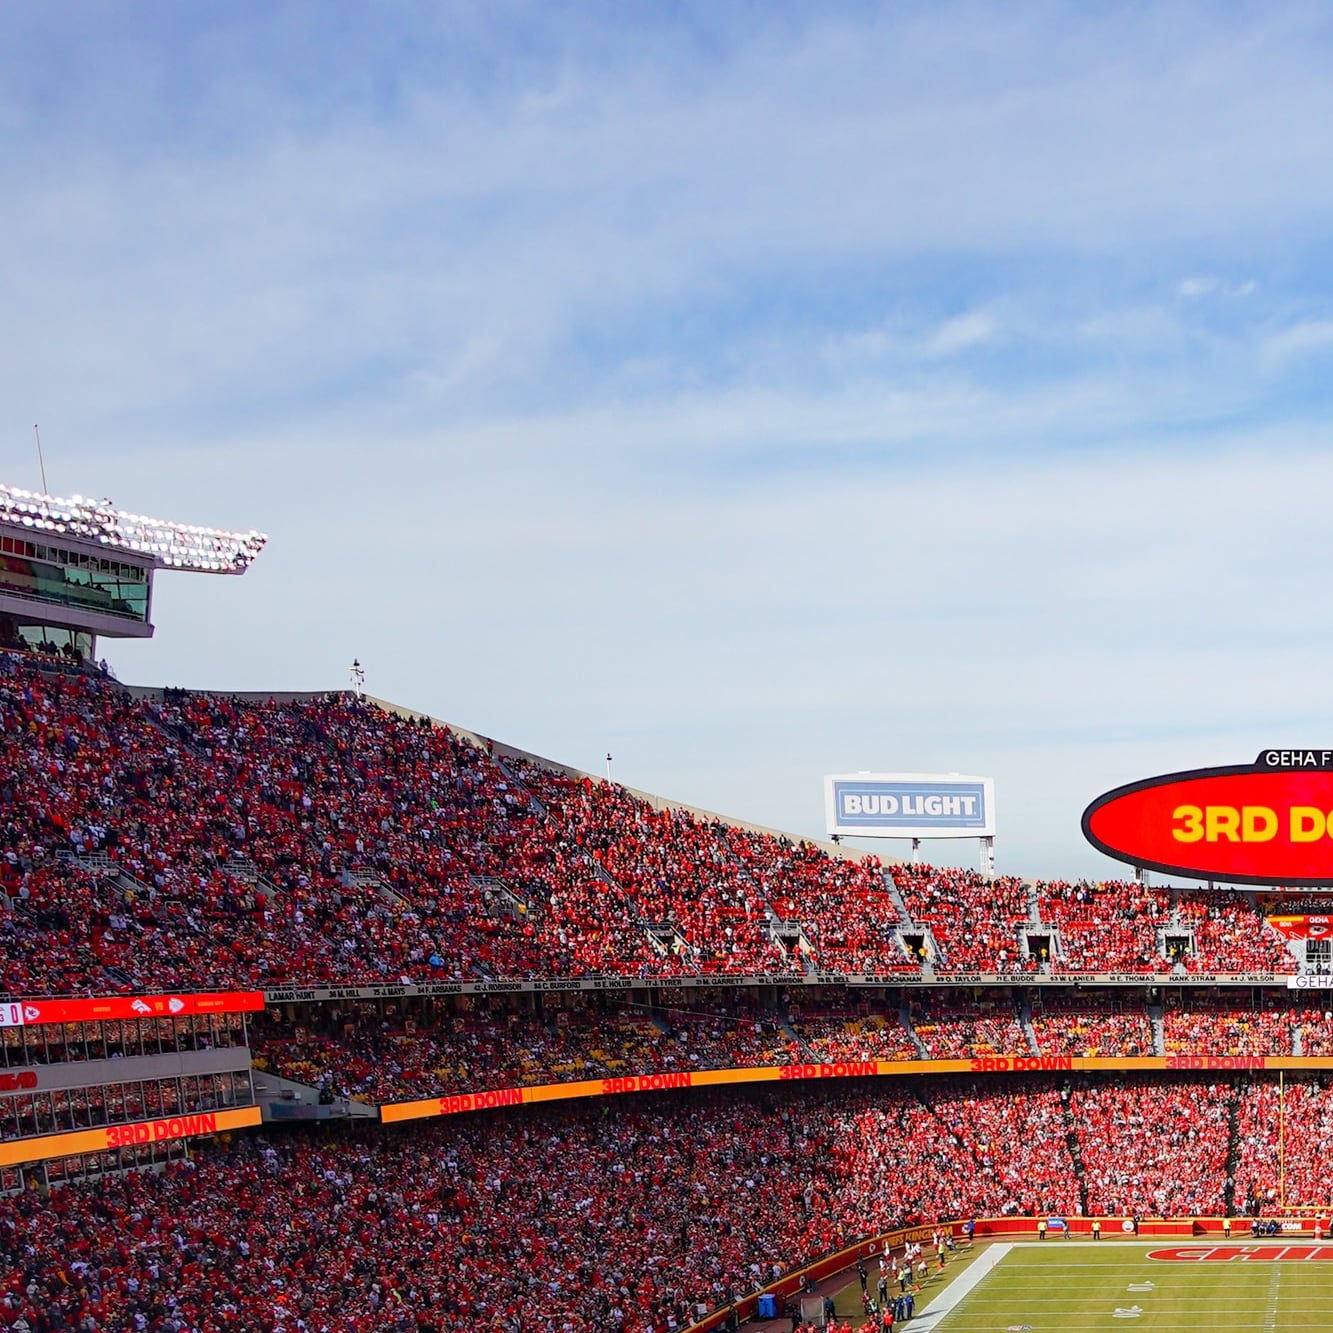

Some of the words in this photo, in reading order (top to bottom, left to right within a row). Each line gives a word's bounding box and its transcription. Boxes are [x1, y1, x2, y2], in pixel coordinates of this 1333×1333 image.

[1266, 751, 1317, 766] GEHA
[844, 794, 898, 815] BUD
[902, 795, 976, 816] LIGHT
[1172, 805, 1278, 843] 3RD
[268, 992, 294, 1001] LAMAR
[296, 991, 315, 1000] HUNT
[779, 1065, 816, 1080] 3RD
[820, 1062, 878, 1078] DOWN
[970, 1058, 1009, 1072] 3RD
[1013, 1056, 1072, 1071] DOWN
[1166, 1056, 1204, 1069] 3RD
[1207, 1056, 1265, 1069] DOWN
[602, 1076, 635, 1095] 3RD
[638, 1072, 692, 1091] DOWN
[440, 1095, 471, 1115] 3RD
[474, 1087, 523, 1111] DOWN
[106, 1121, 150, 1148] 3RD
[151, 1113, 216, 1141] DOWN
[905, 1226, 953, 1242] KINGDM
